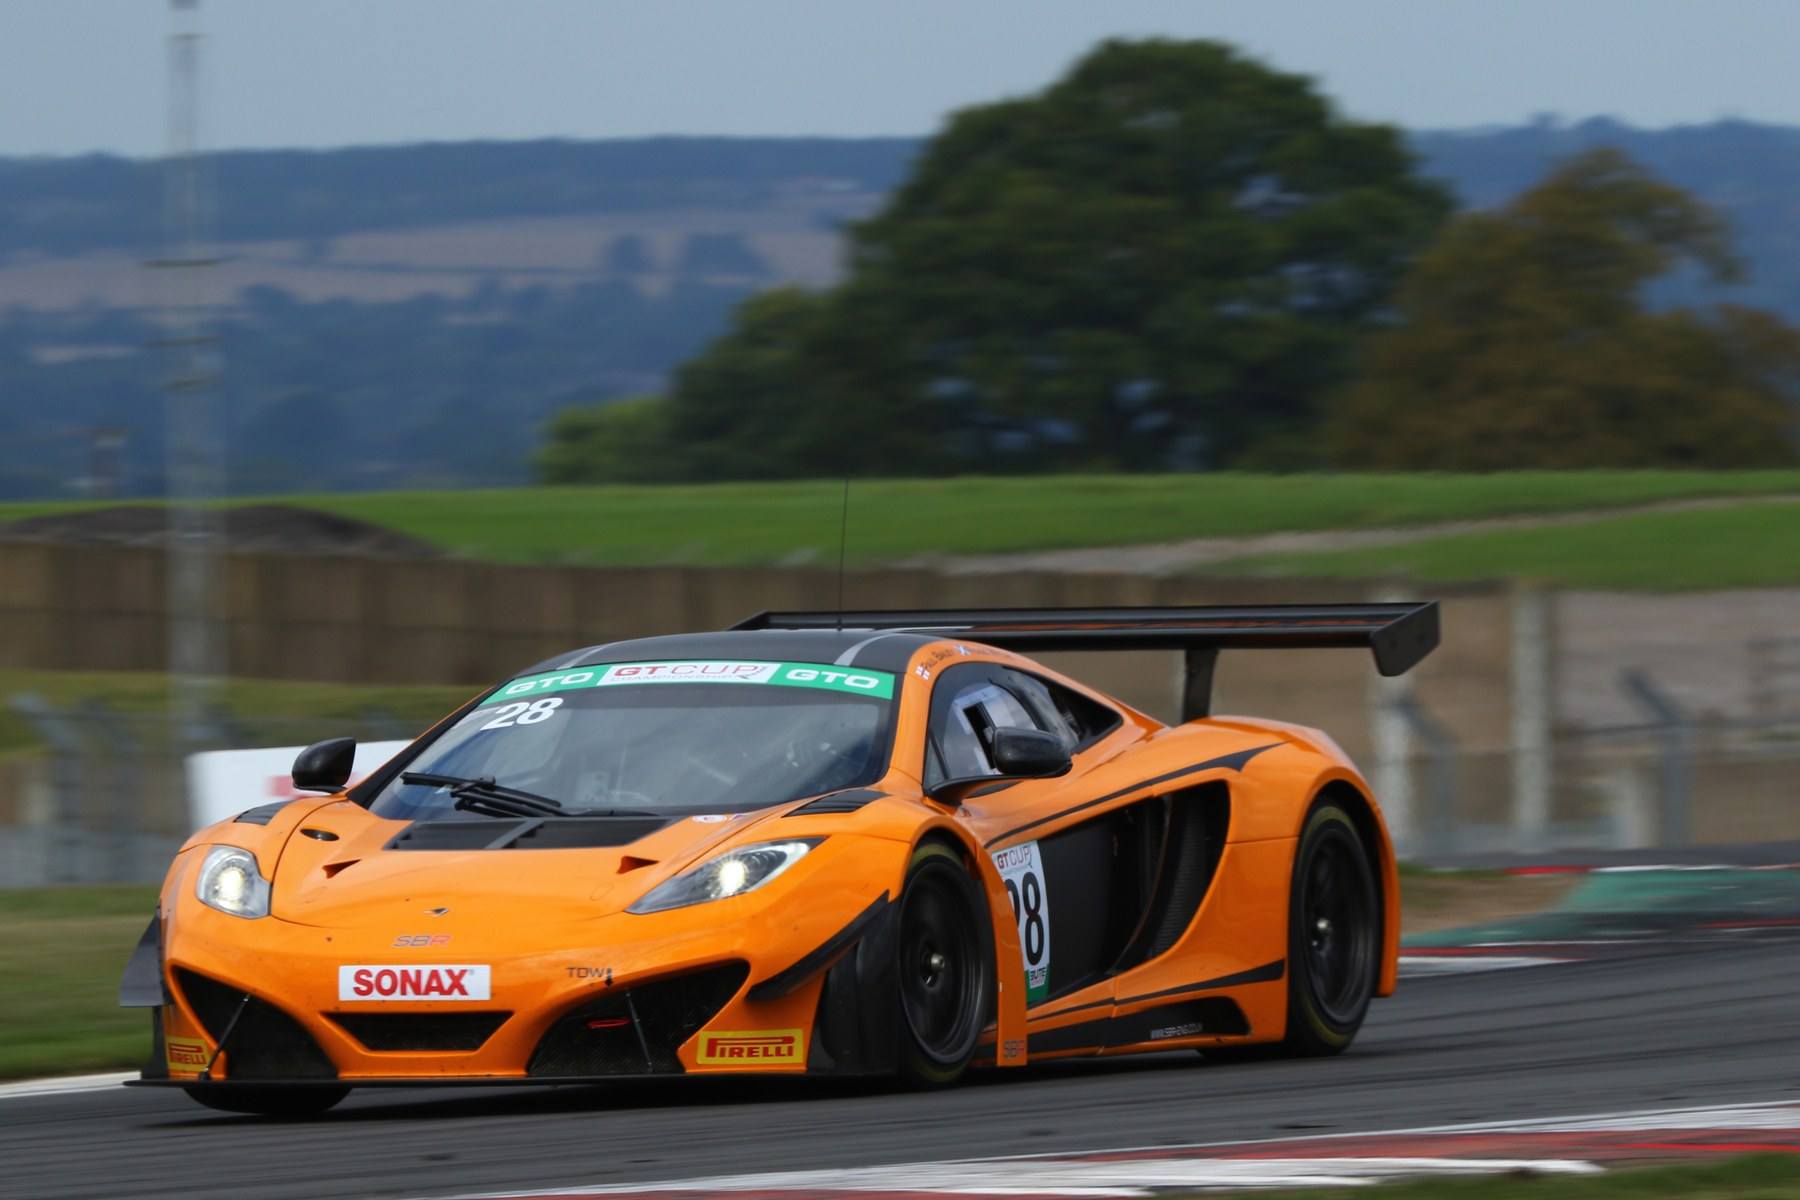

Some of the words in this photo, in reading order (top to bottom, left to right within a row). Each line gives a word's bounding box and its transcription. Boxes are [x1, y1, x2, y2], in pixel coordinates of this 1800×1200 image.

[610, 673, 732, 682] CHAMPIONSHIP
[614, 665, 668, 677] GT
[670, 664, 759, 675] CUP
[786, 668, 880, 689] GTO
[505, 671, 594, 695] GTO
[479, 697, 564, 731] 28
[996, 852, 1009, 870] GT
[1008, 844, 1031, 866] CUP
[392, 934, 452, 947] SBR
[353, 968, 469, 997] SONAX
[565, 966, 605, 979] TOW
[168, 1042, 207, 1065] PIRELLI
[705, 1035, 796, 1058] PIRELLI
[1003, 1039, 1026, 1058] SBR
